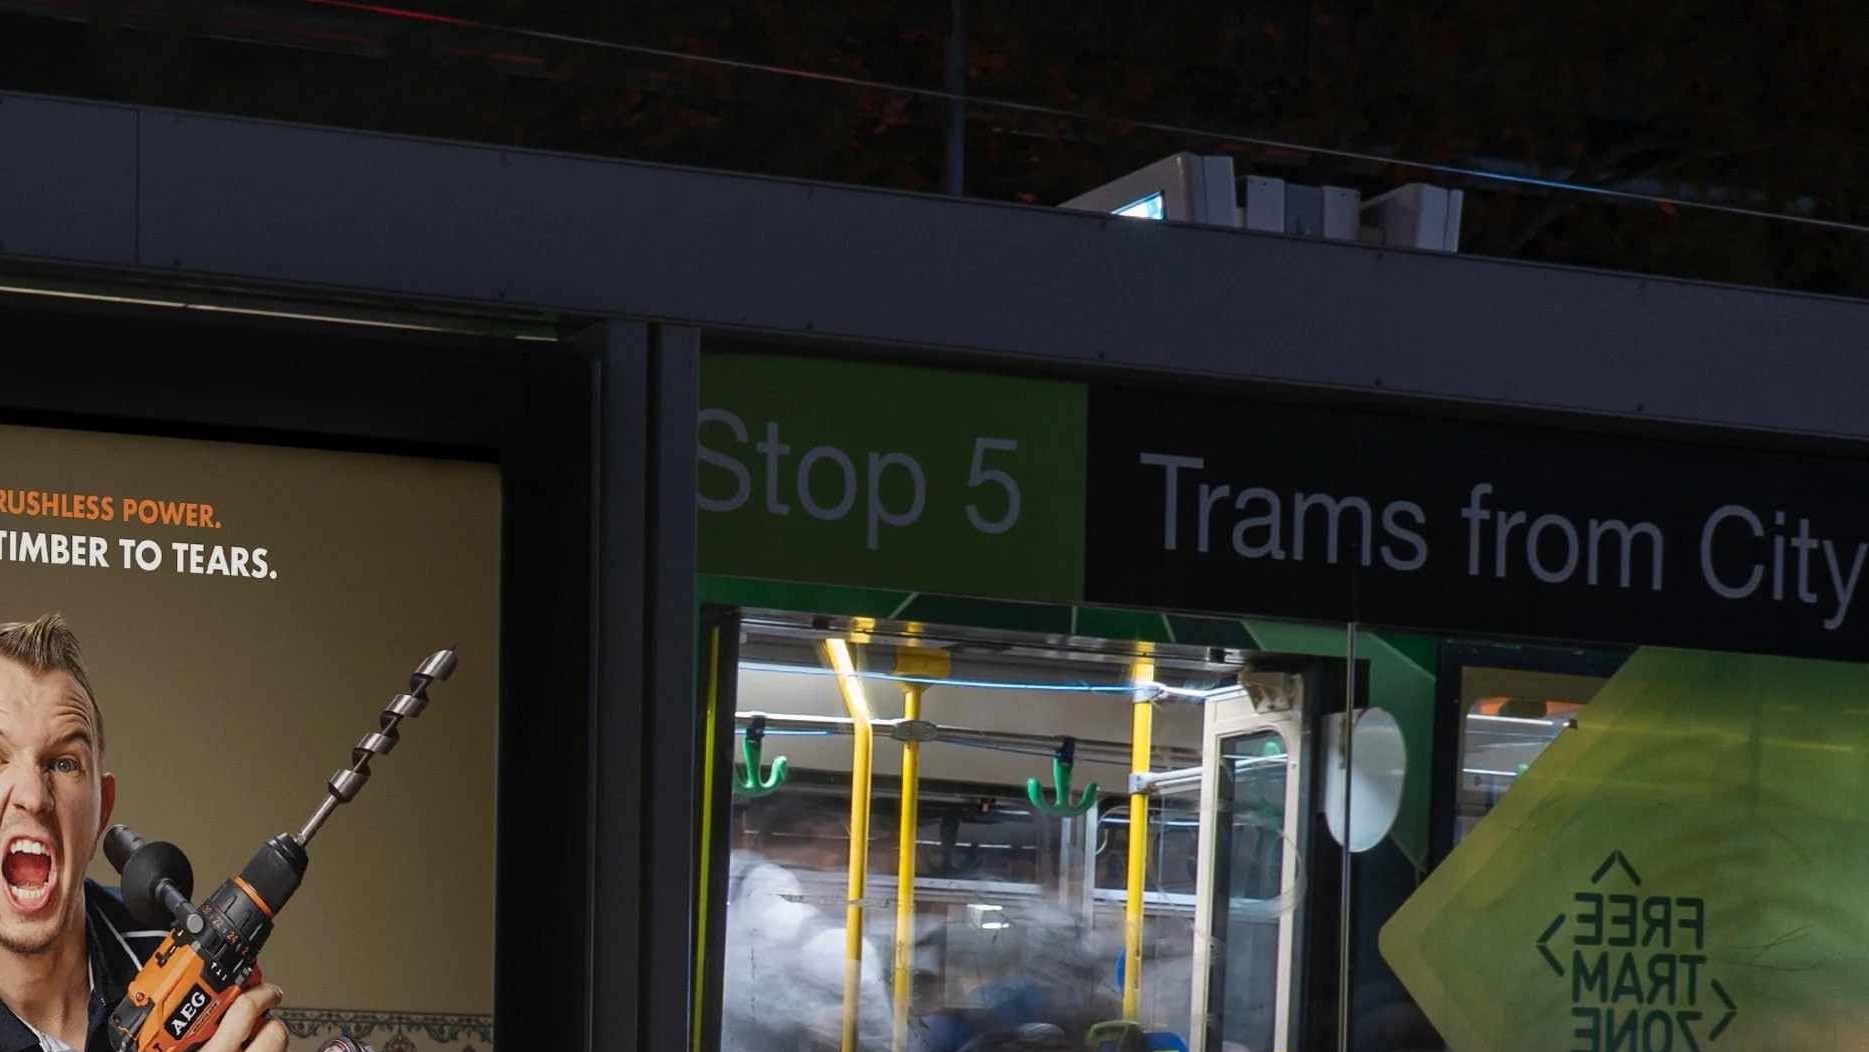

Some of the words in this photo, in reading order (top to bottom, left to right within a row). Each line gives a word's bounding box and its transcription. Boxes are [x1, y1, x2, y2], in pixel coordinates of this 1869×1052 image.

[697, 409, 926, 549] Stop
[965, 437, 1021, 534] 5
[123, 499, 222, 529] POWER.
[119, 539, 163, 571] TO
[172, 542, 278, 580] TEARS.
[1139, 452, 1428, 571] Trams
[1461, 484, 1665, 591] from
[1700, 505, 1869, 631] City
[171, 992, 206, 1036] AEG
